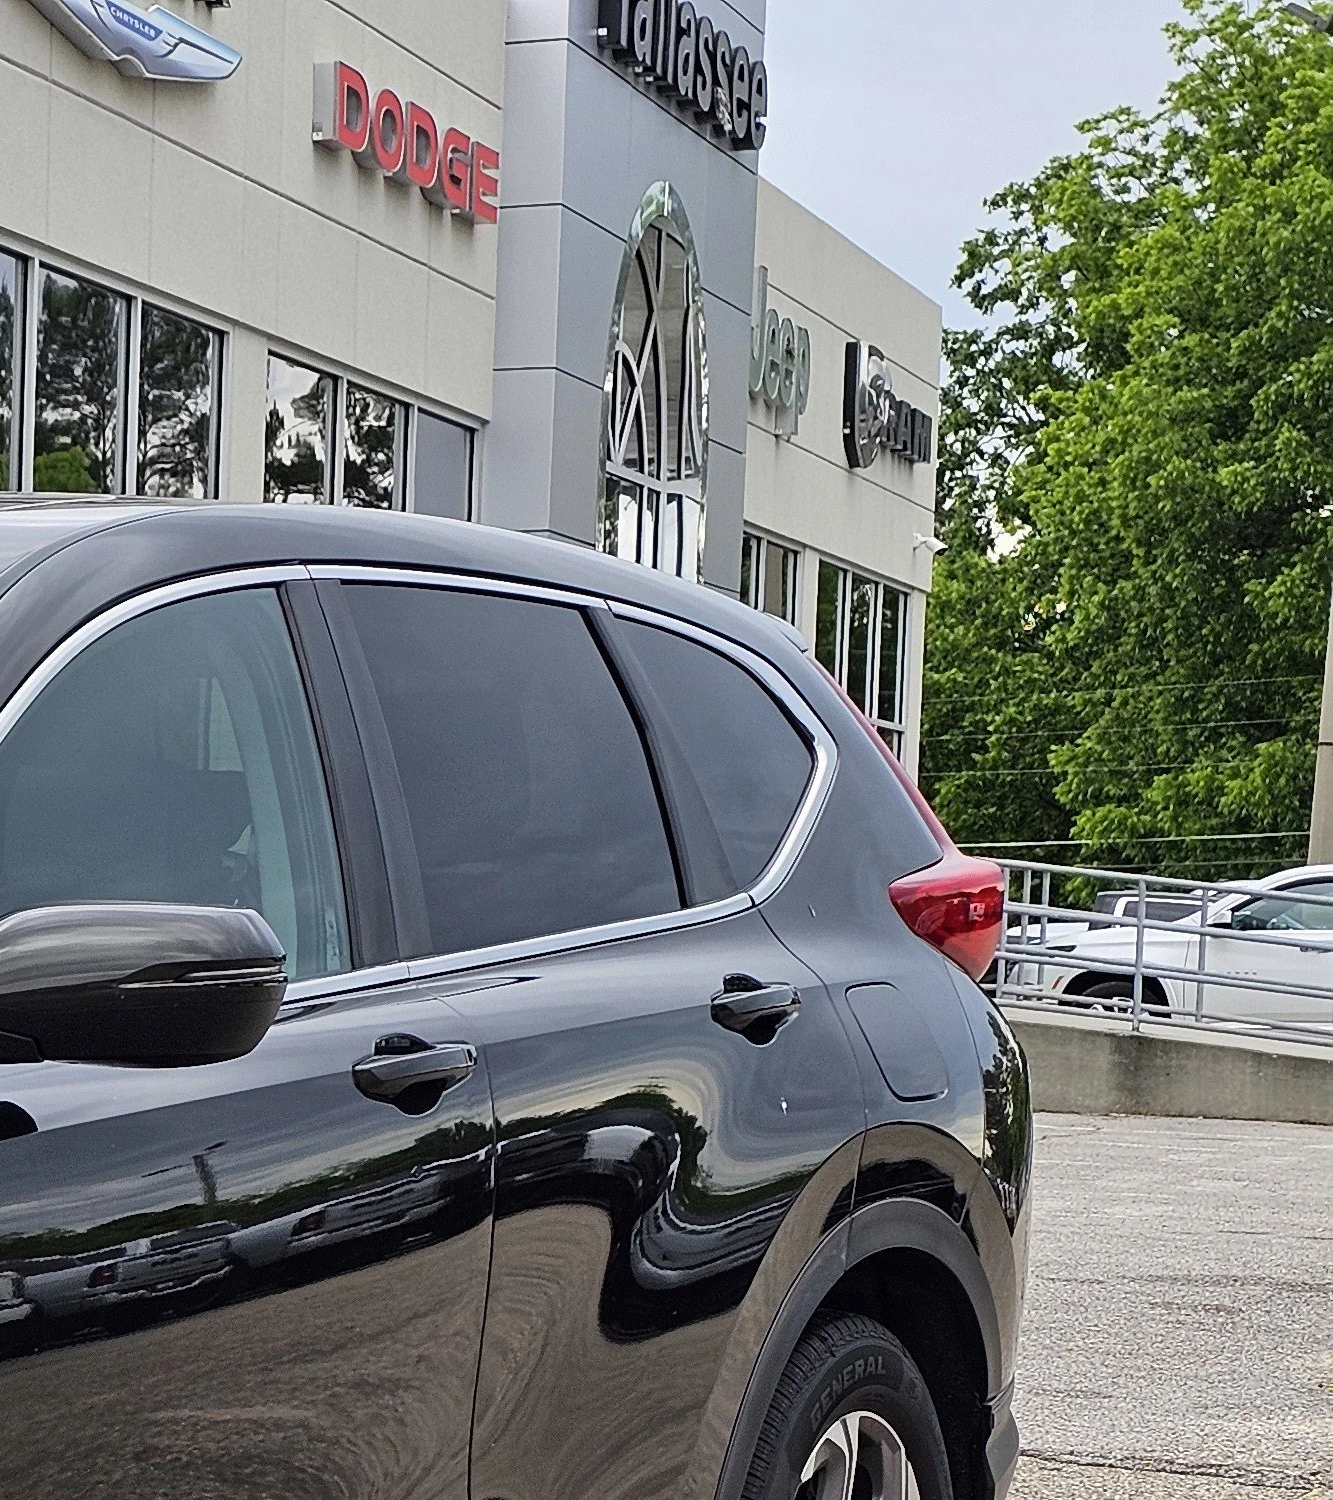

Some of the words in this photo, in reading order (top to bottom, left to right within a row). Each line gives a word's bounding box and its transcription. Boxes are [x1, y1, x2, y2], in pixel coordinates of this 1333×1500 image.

[110, 5, 157, 38] CHRYSLER
[334, 60, 500, 224] DODGE
[749, 265, 811, 435] Jeep
[809, 1354, 888, 1434] GENERAL
